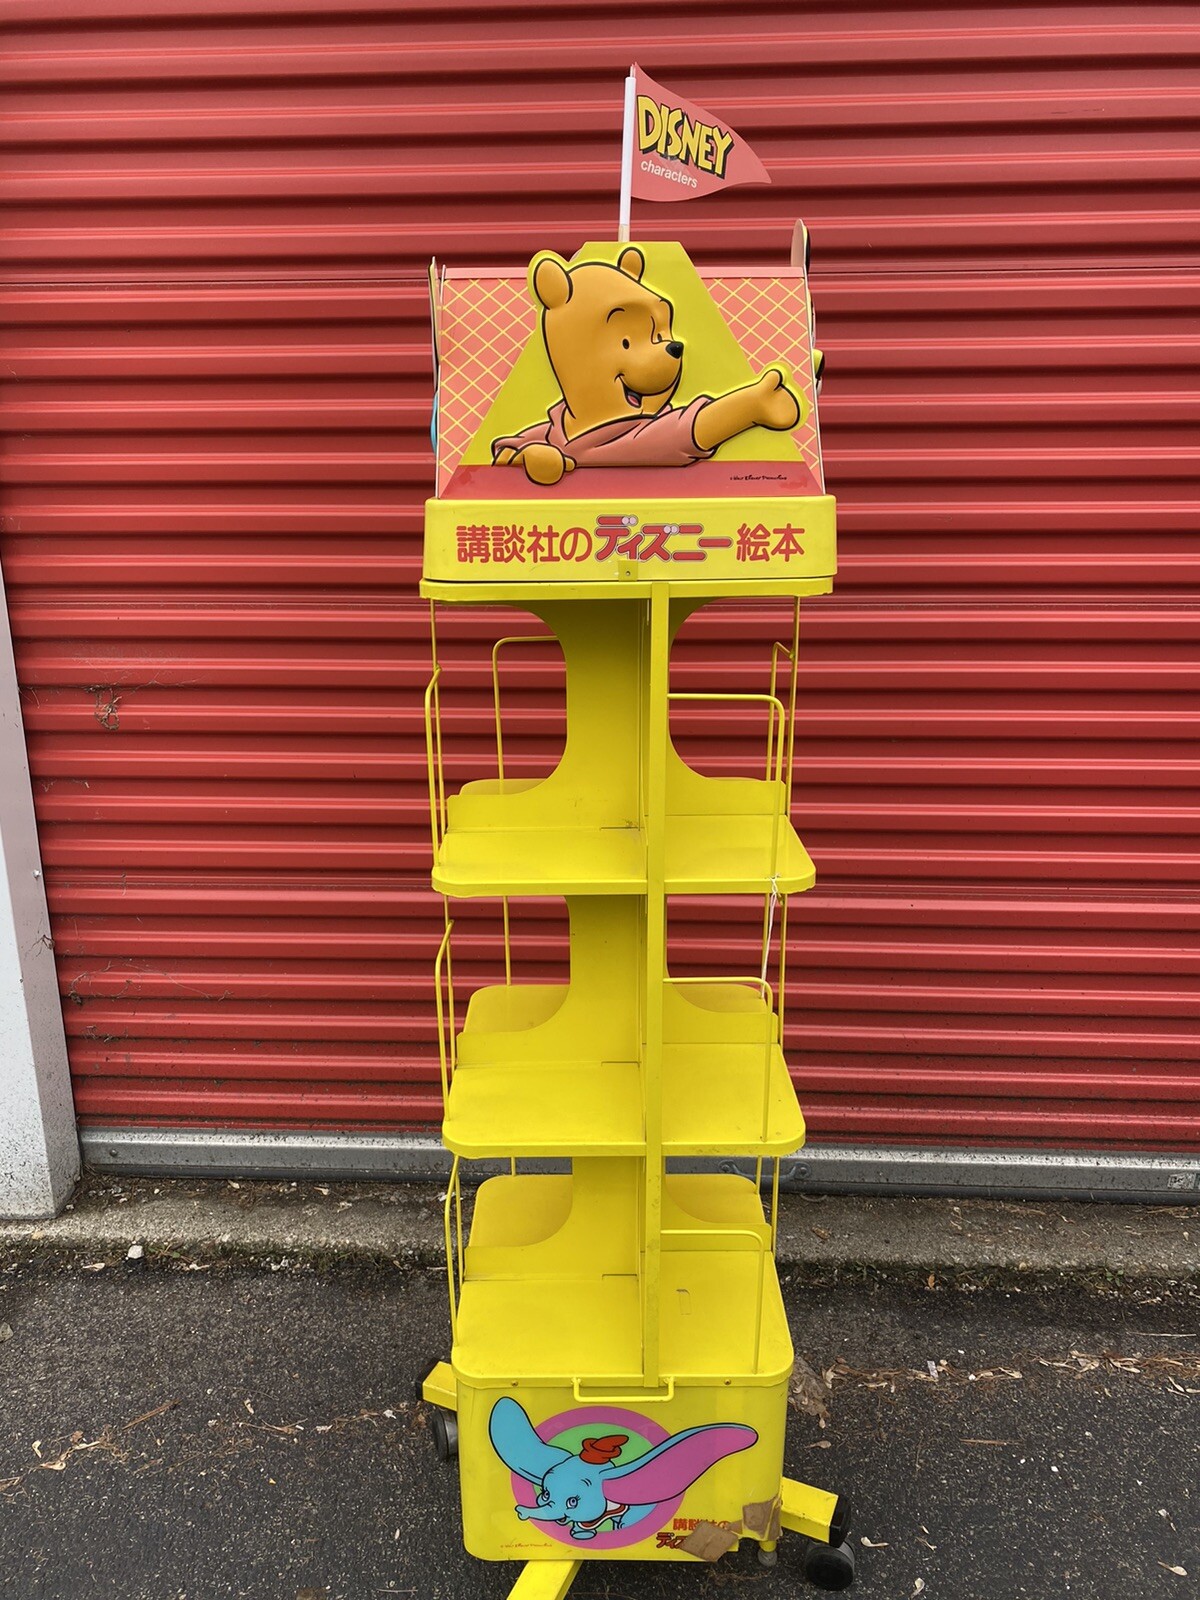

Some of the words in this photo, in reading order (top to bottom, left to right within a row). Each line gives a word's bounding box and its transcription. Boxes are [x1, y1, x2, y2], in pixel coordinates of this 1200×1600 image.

[637, 95, 734, 179] DISNEY
[640, 159, 698, 189] characters
[456, 514, 805, 563] 講談社のディズニー絵本
